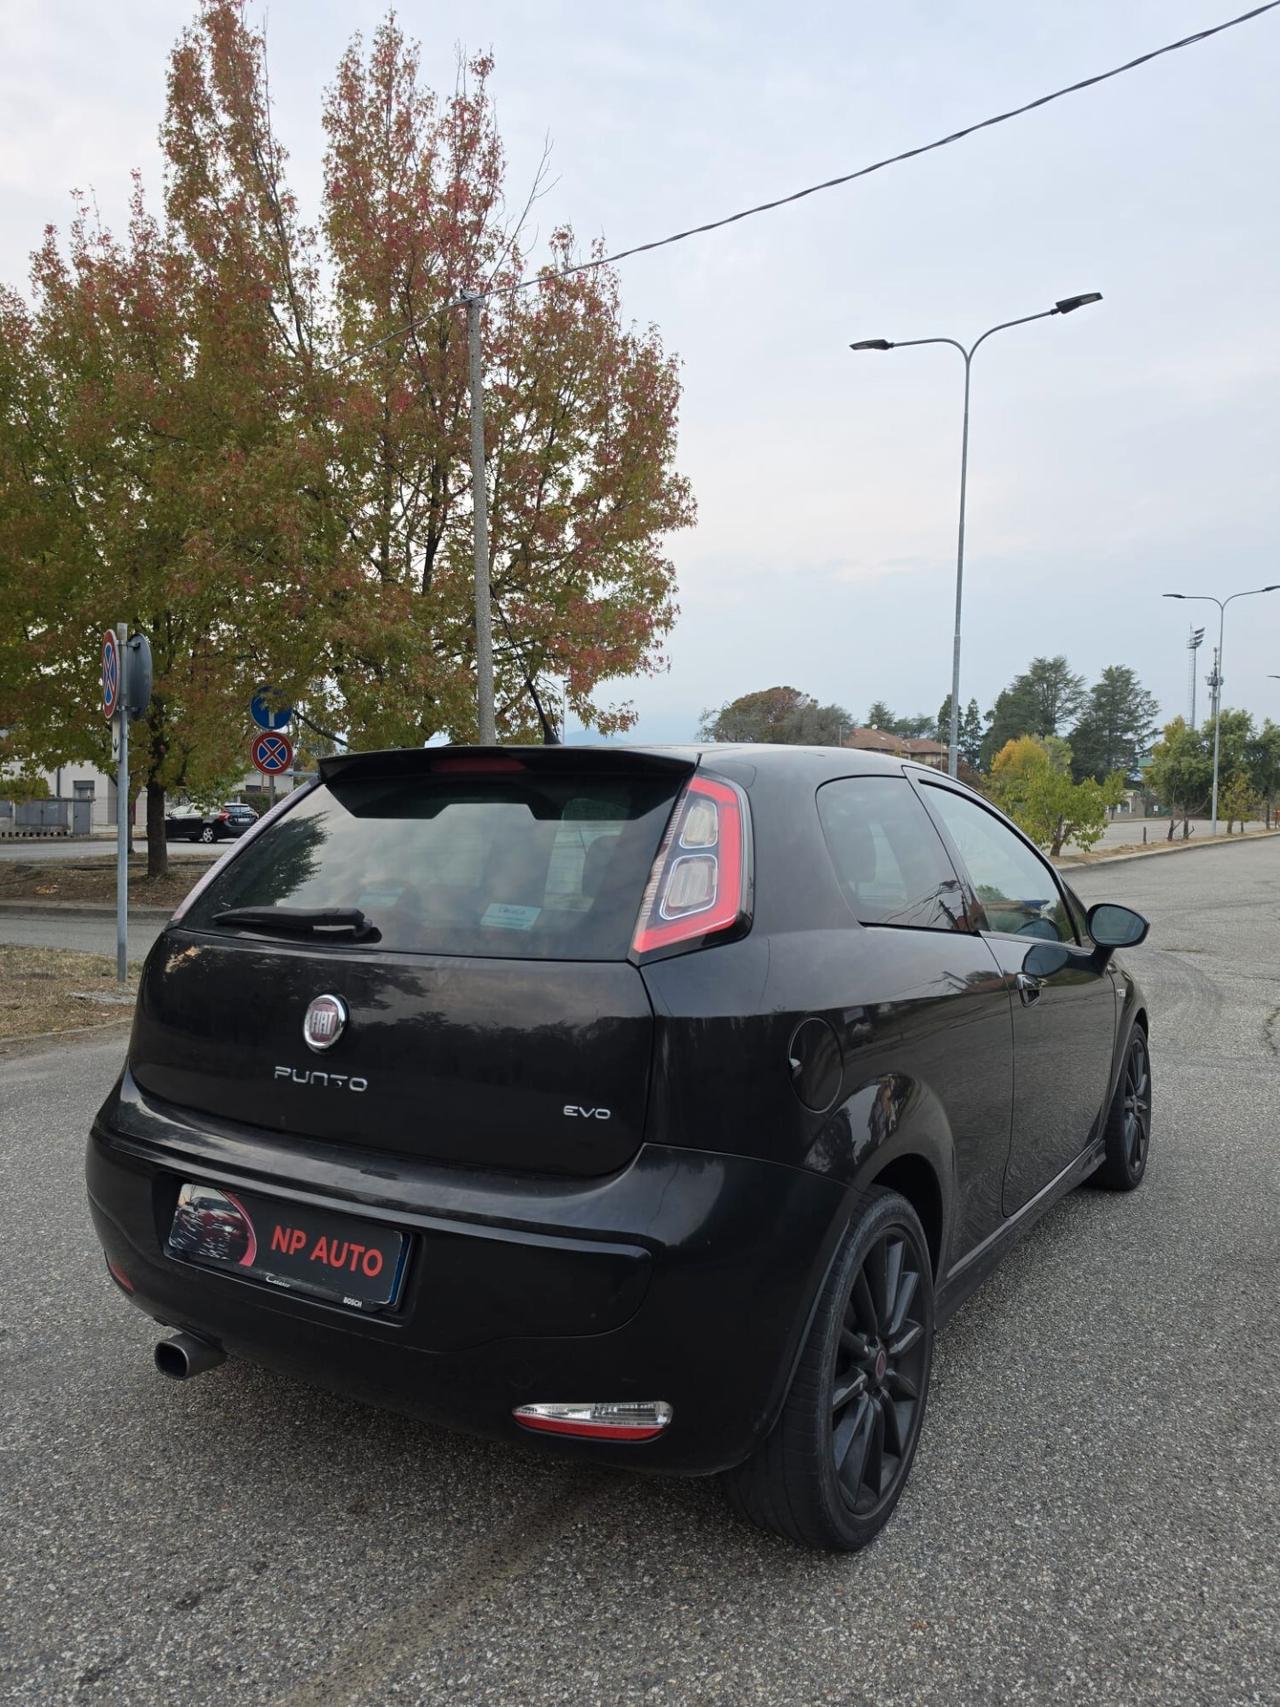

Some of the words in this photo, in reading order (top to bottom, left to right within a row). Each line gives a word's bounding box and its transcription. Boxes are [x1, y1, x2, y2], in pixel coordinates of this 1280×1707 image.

[311, 1010, 336, 1035] FIAT
[274, 1066, 369, 1092] PUNTO
[563, 1105, 612, 1120] EVO
[271, 1225, 306, 1255] NP
[310, 1236, 383, 1277] AUTO
